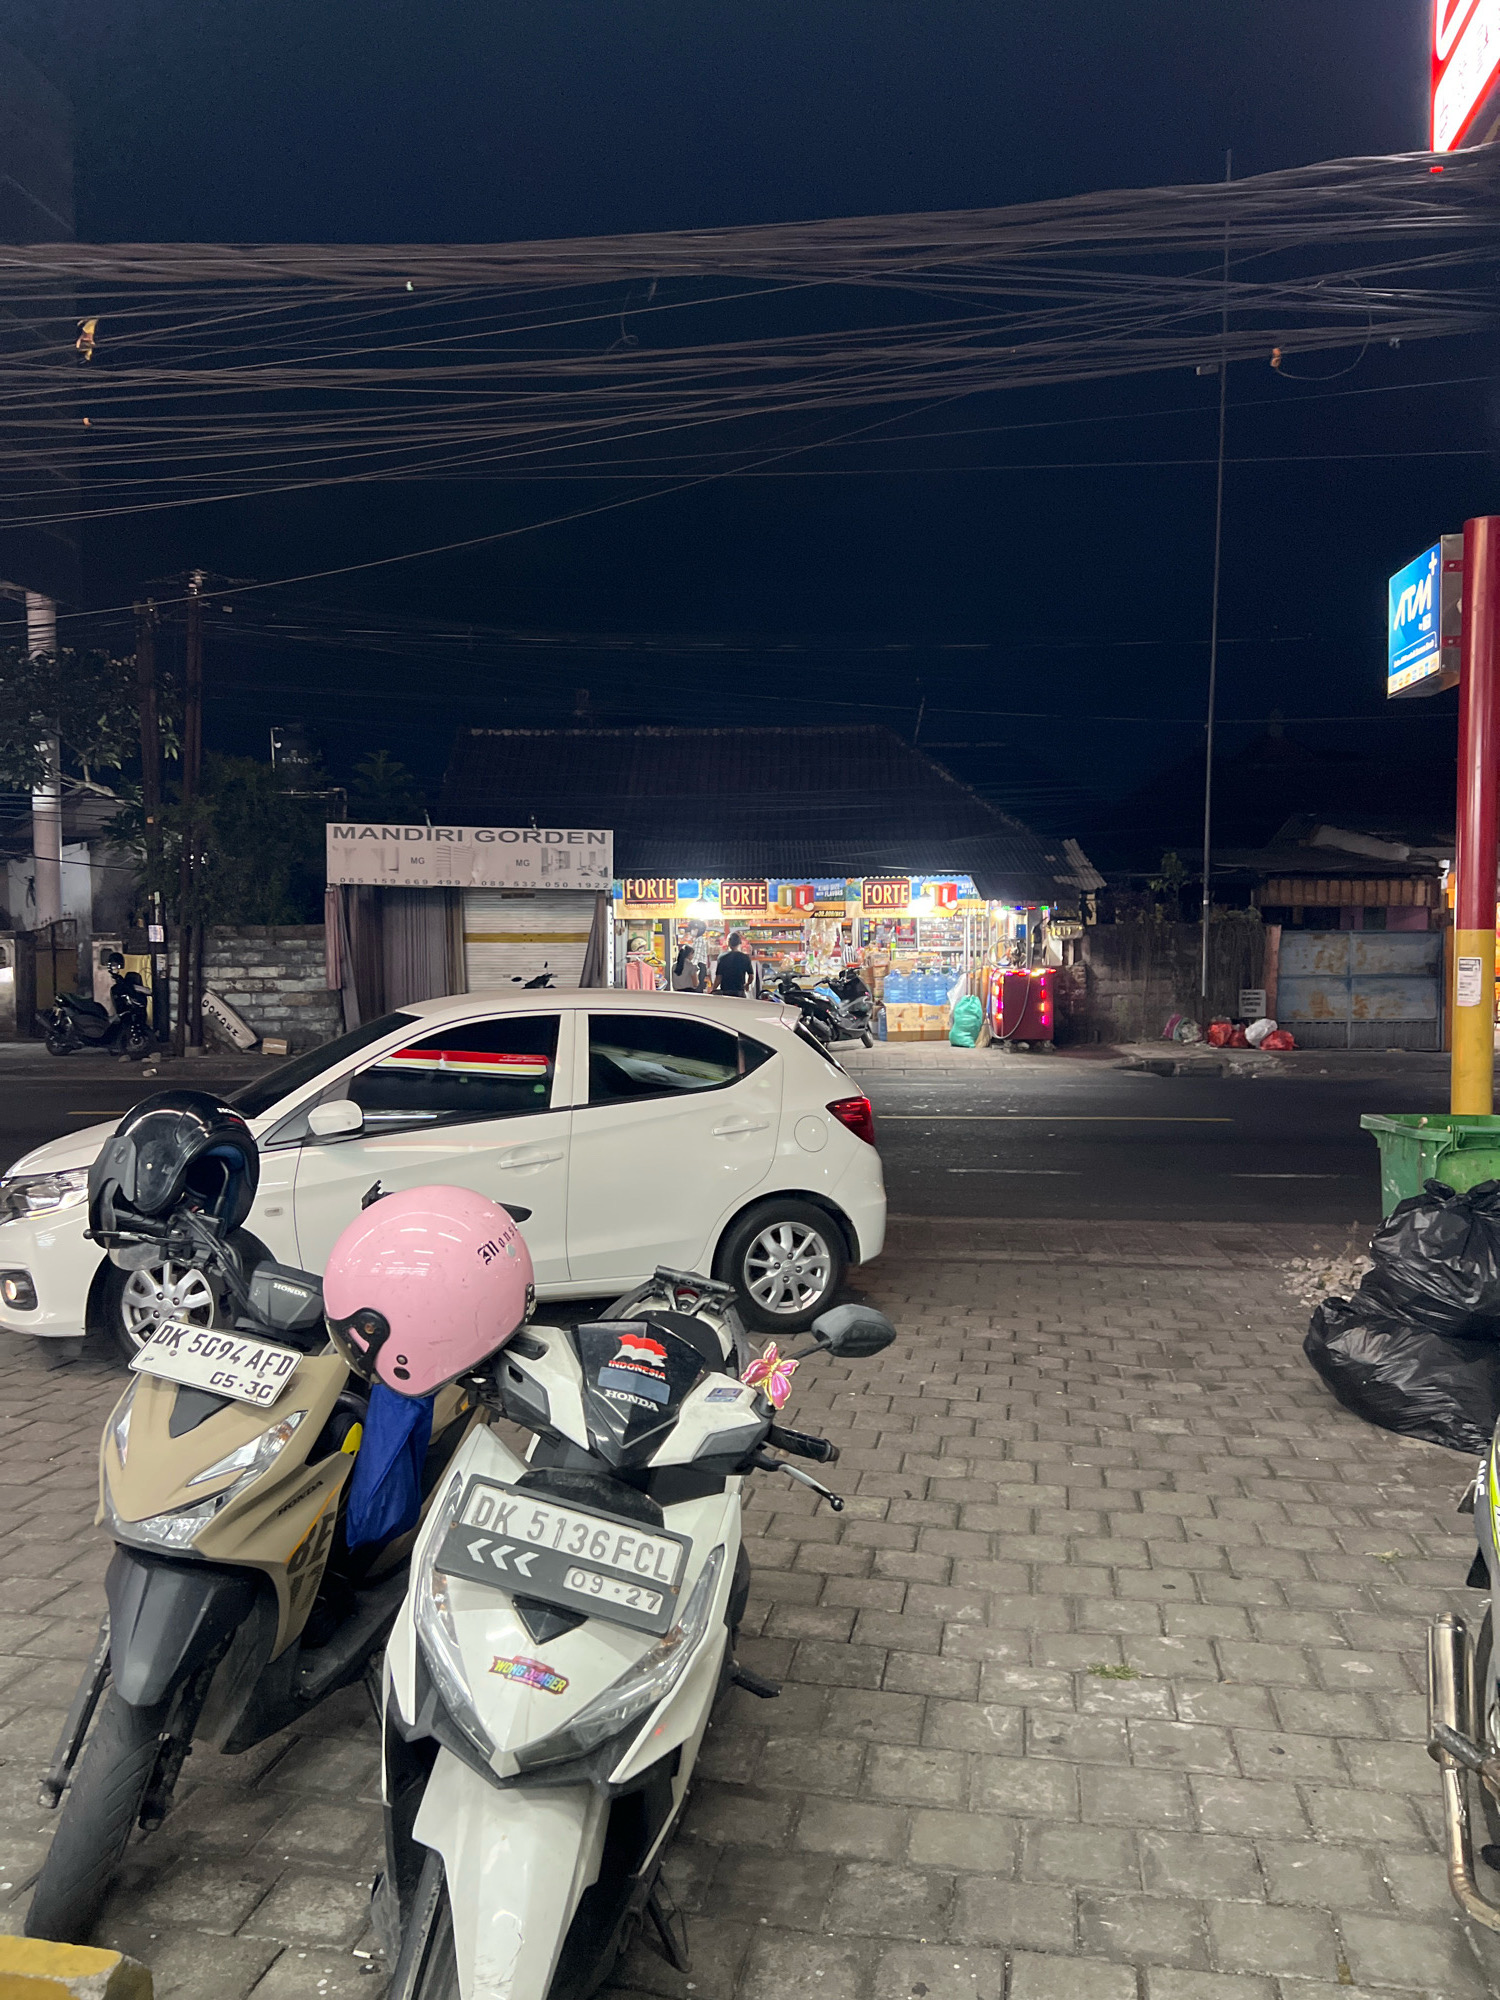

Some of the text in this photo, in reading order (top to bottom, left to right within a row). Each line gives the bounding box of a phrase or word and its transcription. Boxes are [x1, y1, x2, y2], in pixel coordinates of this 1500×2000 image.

[333, 825, 606, 844] MANDIRI GORDEN
[410, 856, 425, 865] MG
[515, 858, 531, 867] MG
[626, 879, 675, 899] FORTE
[722, 886, 766, 906] FORTE
[864, 884, 908, 904] FORTE
[273, 1282, 308, 1298] HONDA
[153, 1325, 189, 1349] DK
[244, 1349, 294, 1376] AFD
[608, 1360, 667, 1380] INDONESIA
[604, 1389, 660, 1412] HONDA
[277, 1480, 324, 1517] HONDA
[470, 1495, 518, 1535] DK
[494, 1660, 526, 1677] WONG
